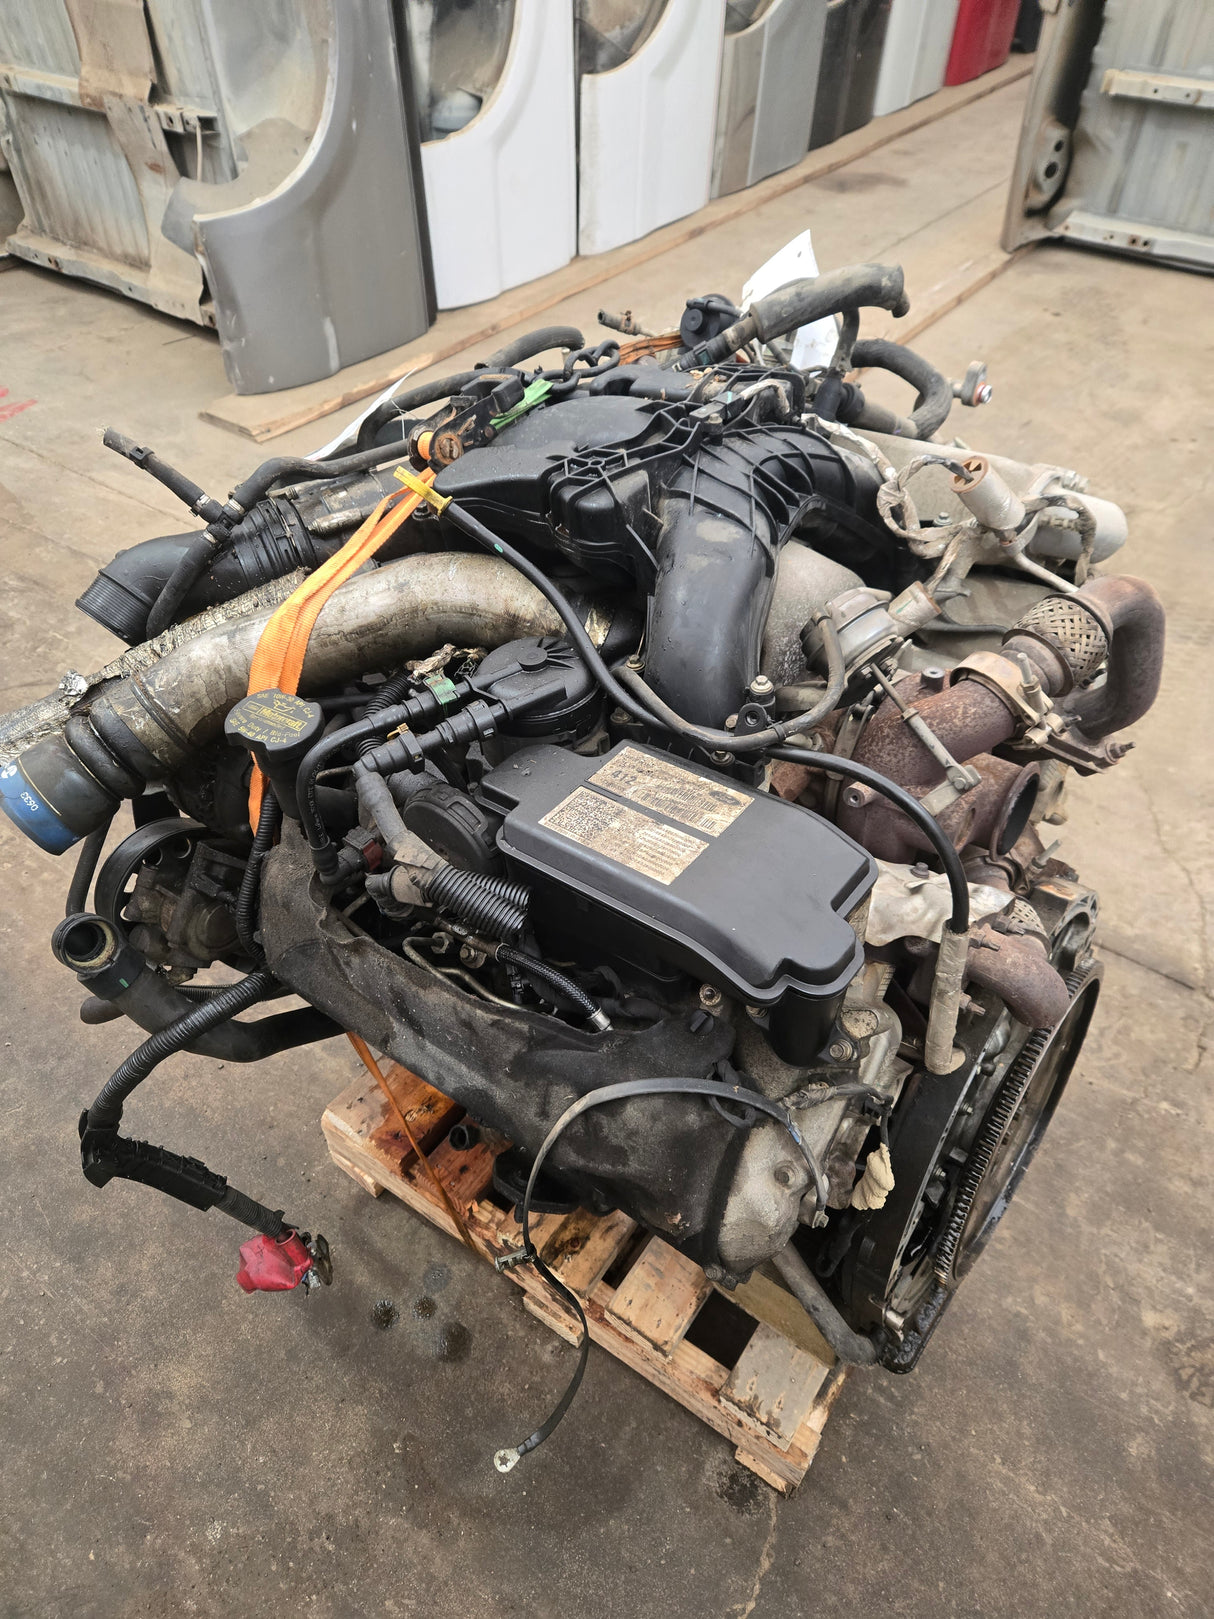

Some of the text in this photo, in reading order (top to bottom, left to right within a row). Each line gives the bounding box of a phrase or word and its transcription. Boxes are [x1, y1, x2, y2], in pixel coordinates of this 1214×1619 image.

[247, 722, 262, 733] Duty
[255, 734, 268, 742] API
[270, 736, 288, 744] CJ-4
[610, 769, 638, 786] 412
[20, 791, 39, 812] 0633
